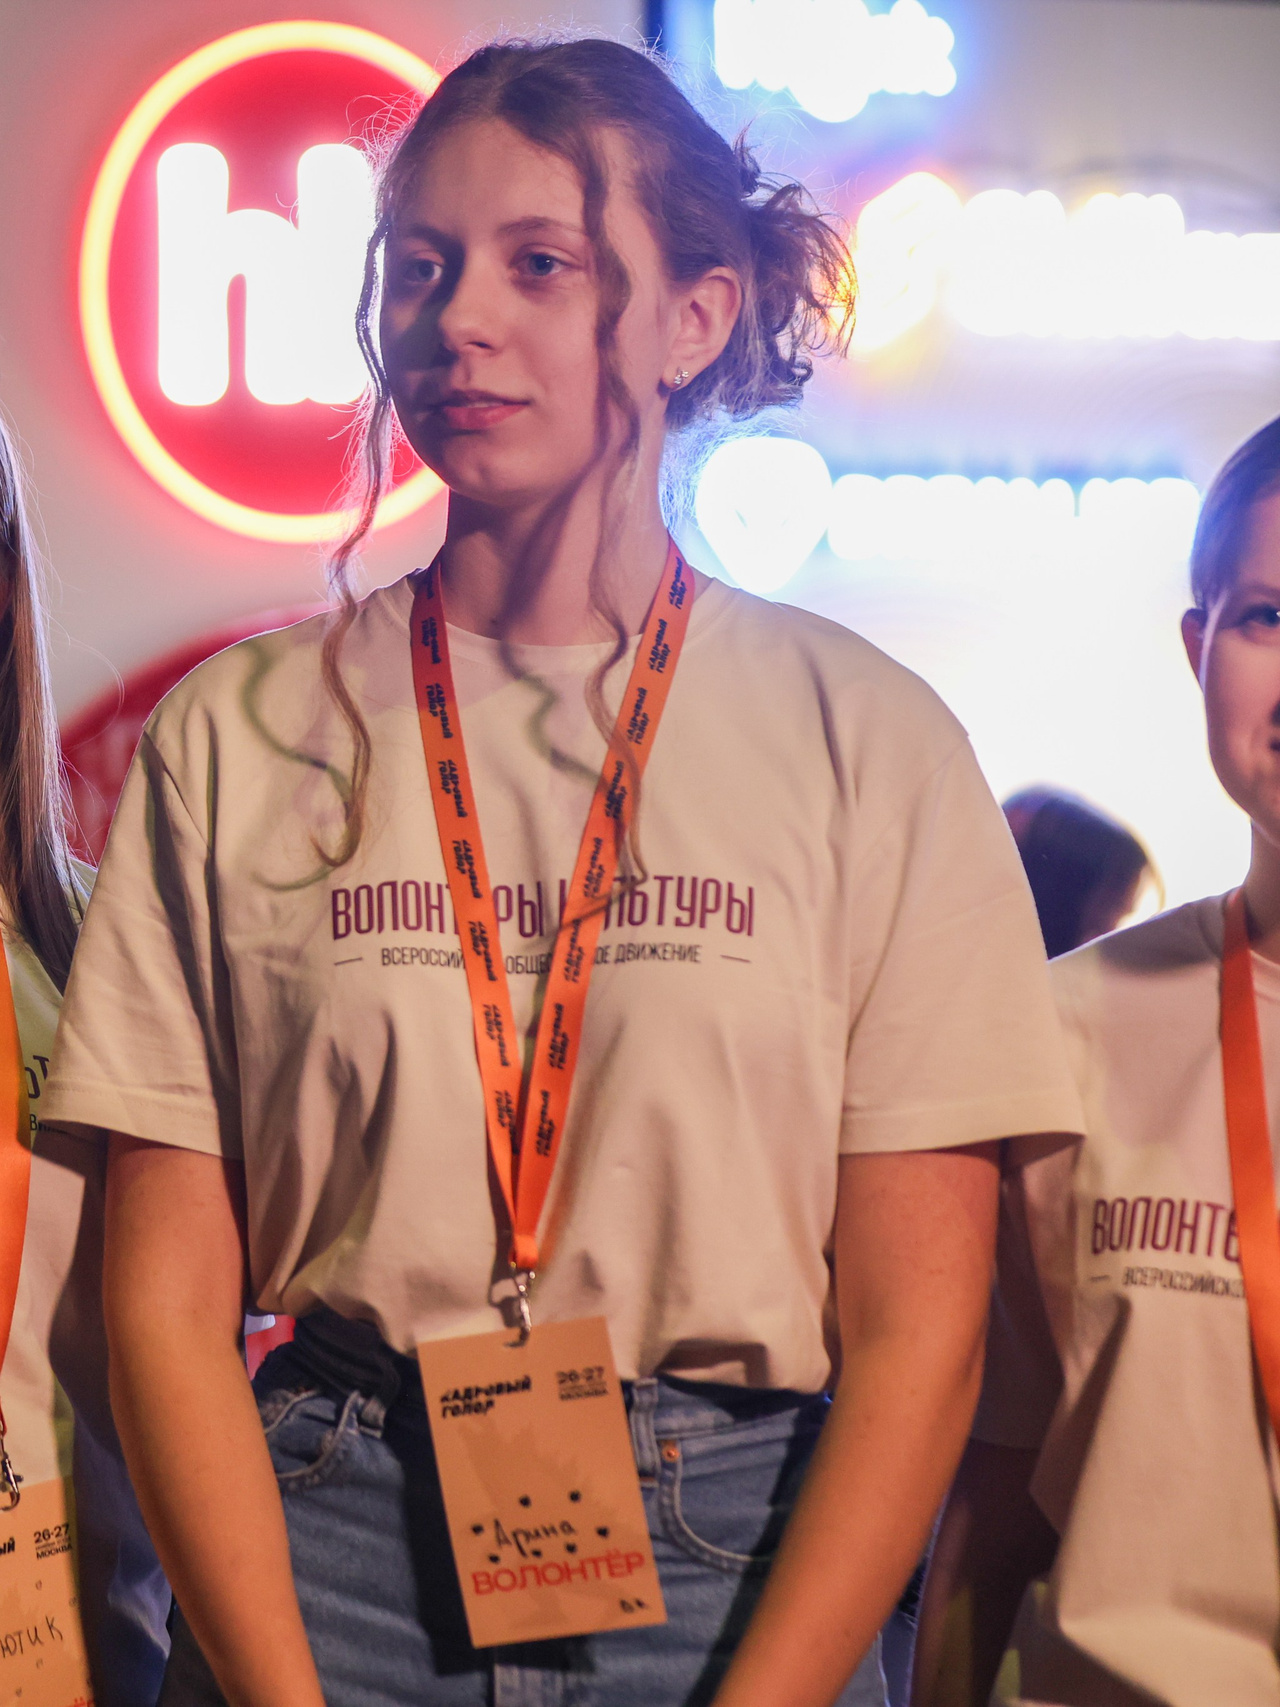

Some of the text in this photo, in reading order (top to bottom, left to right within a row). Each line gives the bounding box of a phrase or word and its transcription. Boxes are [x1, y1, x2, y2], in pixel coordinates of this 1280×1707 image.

[331, 877, 545, 940] ВОЛОНРЫ
[381, 946, 465, 970] ВСЕРОССИЙ
[493, 1517, 577, 1558] Арина
[471, 1550, 646, 1596] ВОЛОНТЁР
